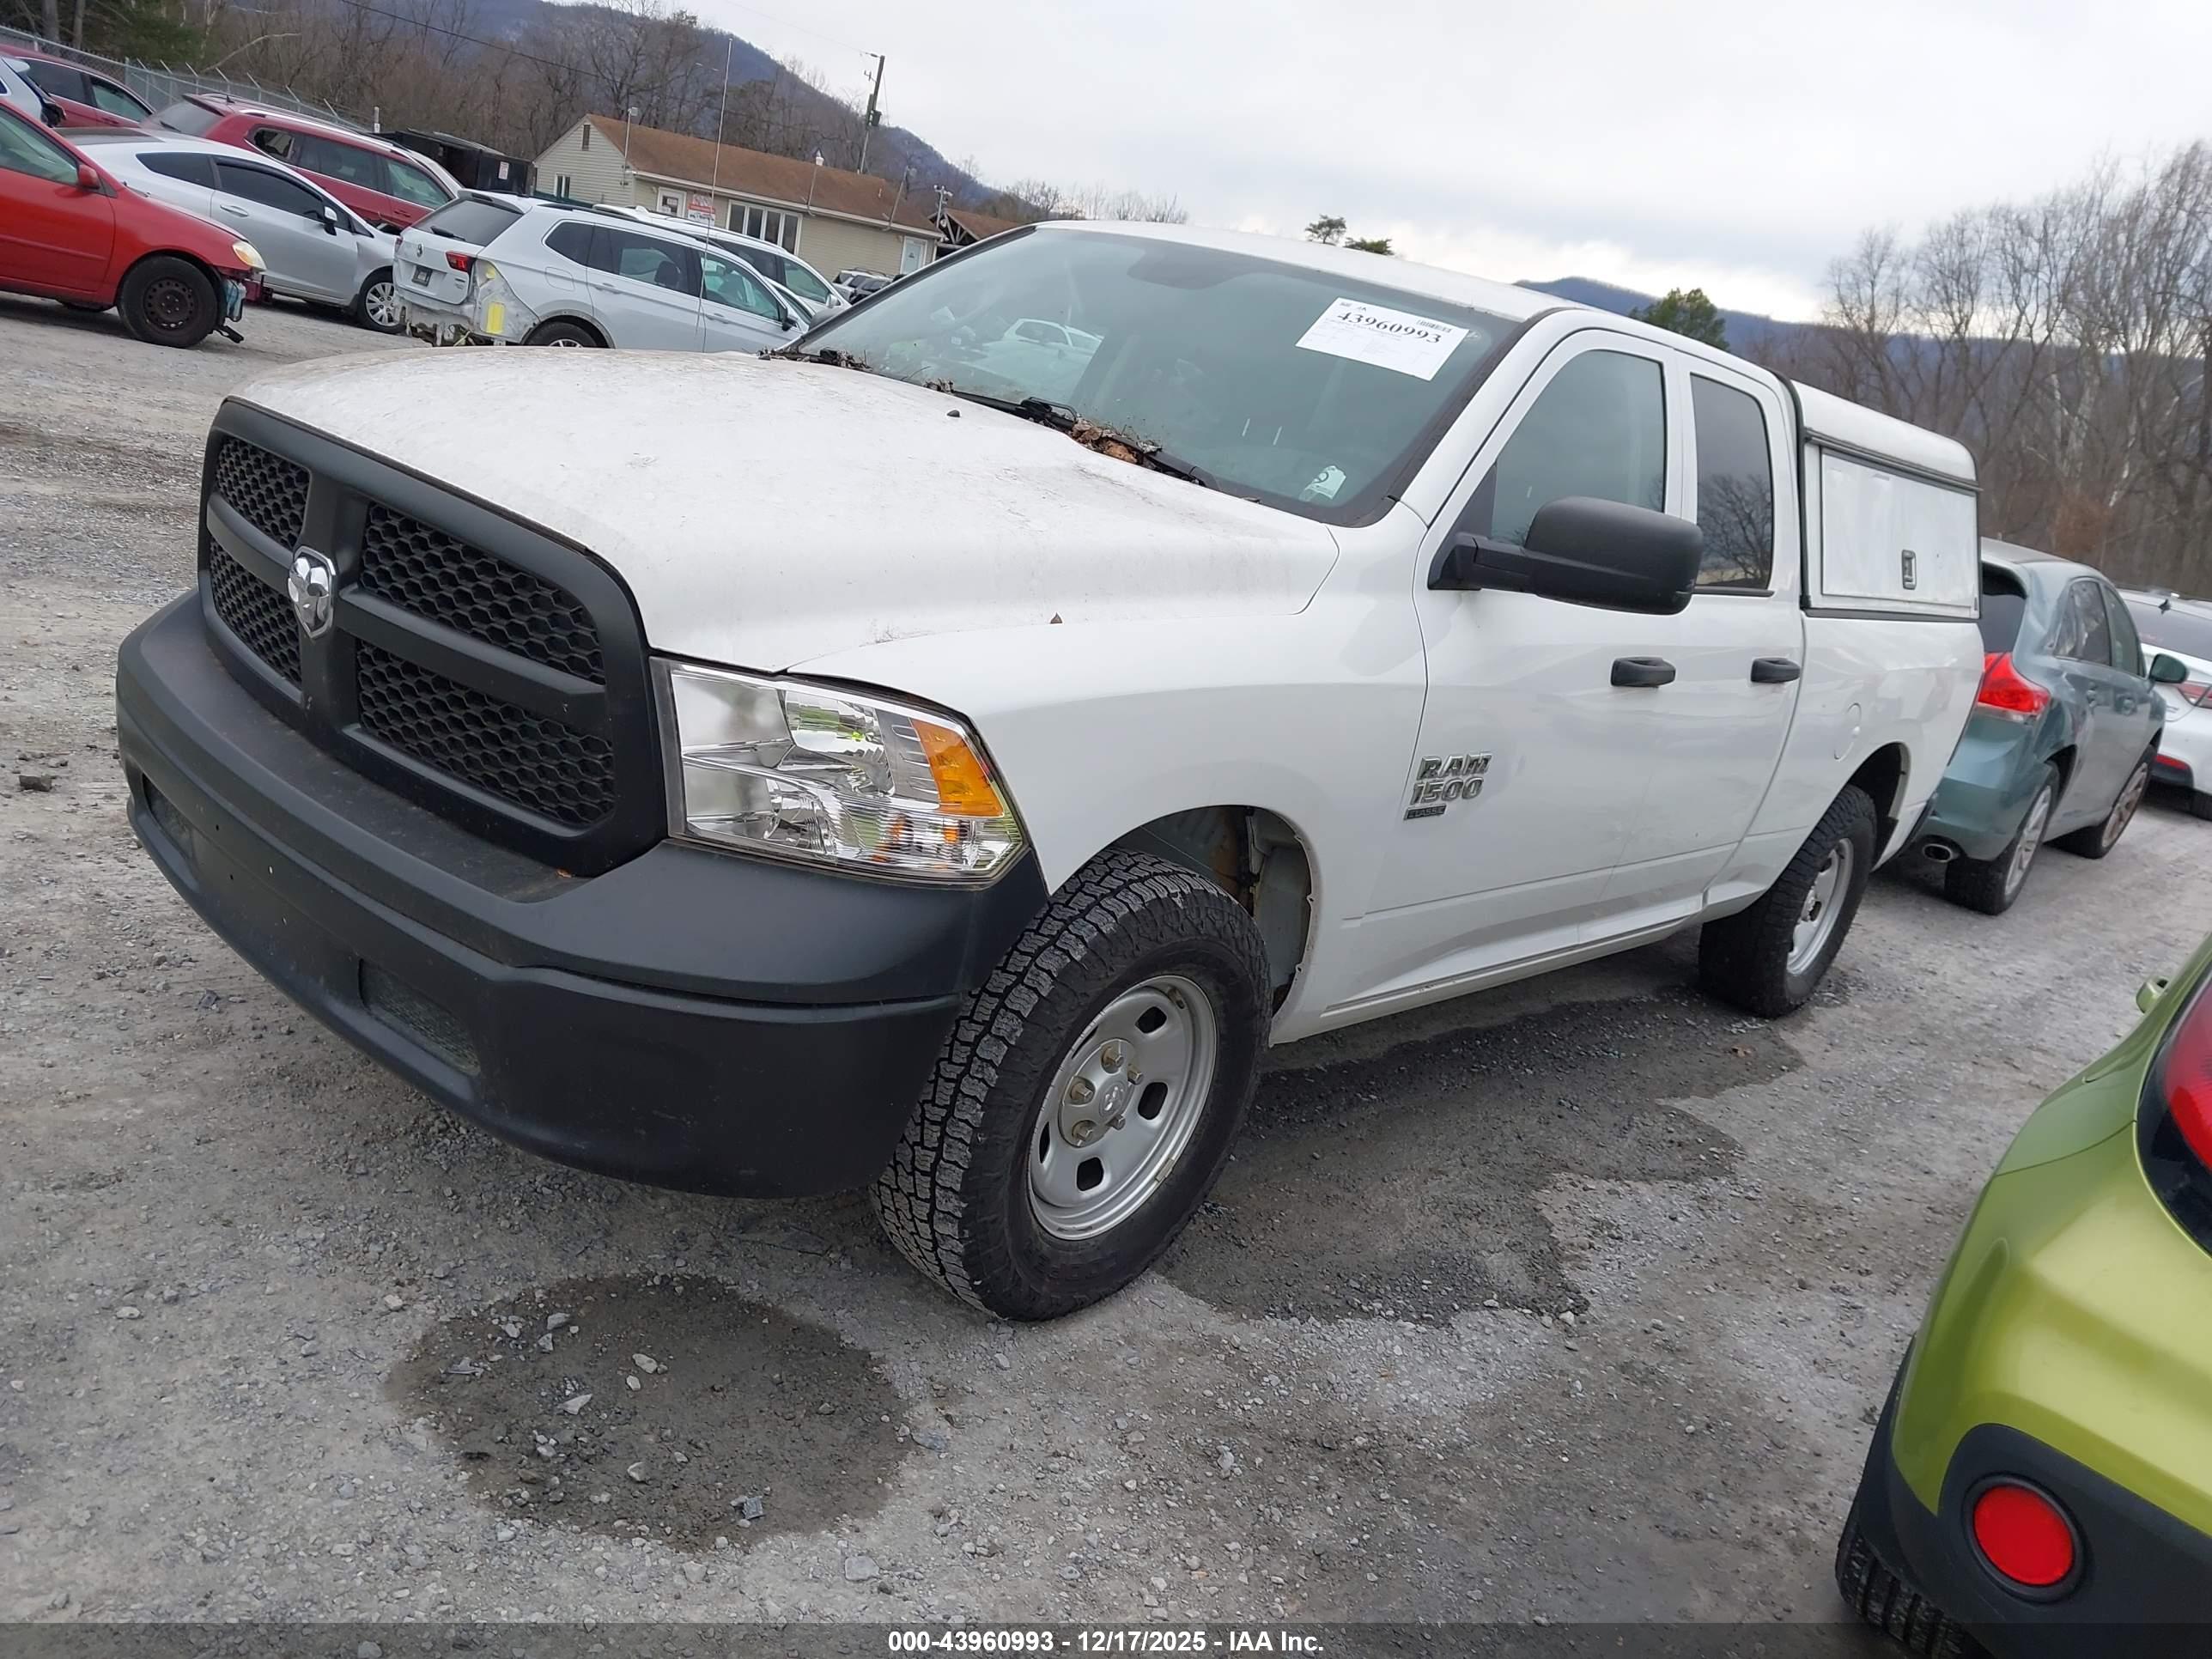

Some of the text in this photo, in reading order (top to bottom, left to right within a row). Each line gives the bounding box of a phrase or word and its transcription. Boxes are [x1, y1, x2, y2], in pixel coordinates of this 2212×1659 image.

[1337, 312, 1442, 343] 43960993
[1416, 753, 1492, 781] RAM
[1410, 777, 1483, 805] 1500
